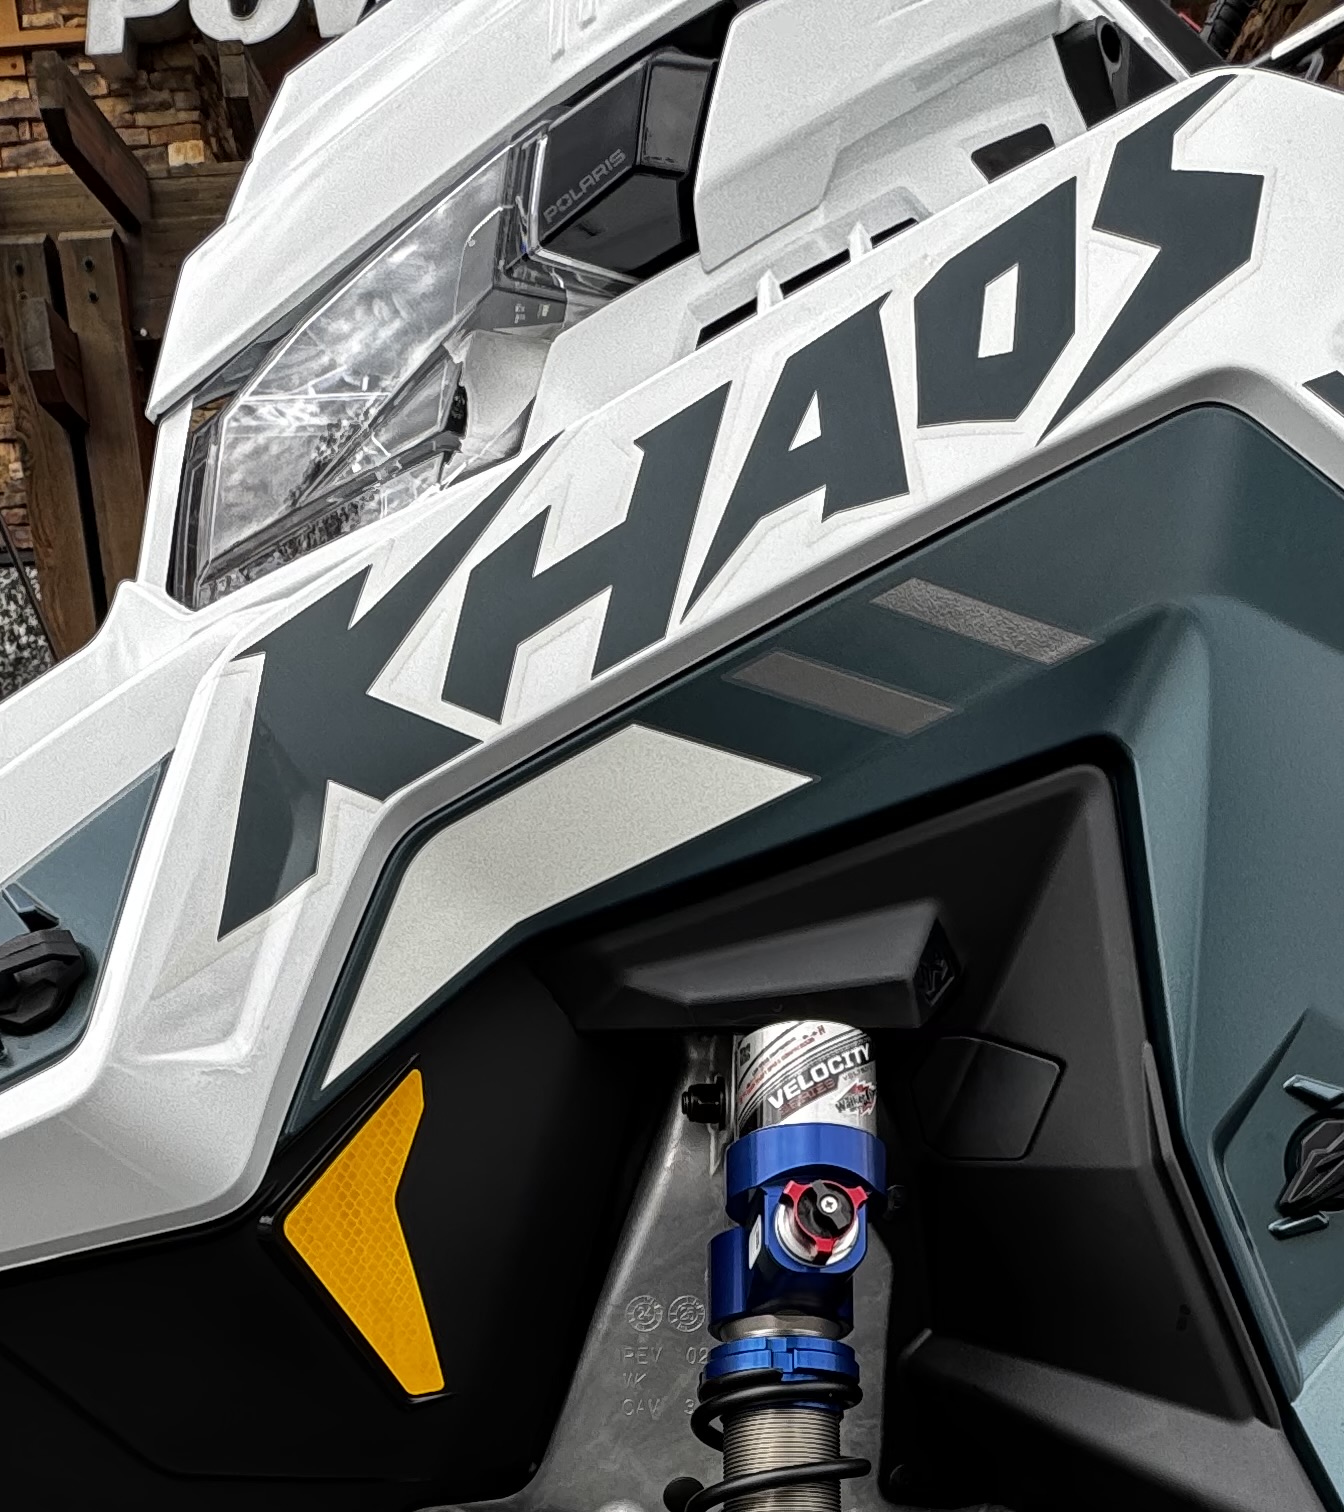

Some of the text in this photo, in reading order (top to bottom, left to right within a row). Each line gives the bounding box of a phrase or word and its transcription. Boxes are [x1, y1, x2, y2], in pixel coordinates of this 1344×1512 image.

[543, 149, 627, 223] POLARIS
[218, 74, 1263, 940] KHAOS
[767, 1042, 870, 1109] VELOCITY
